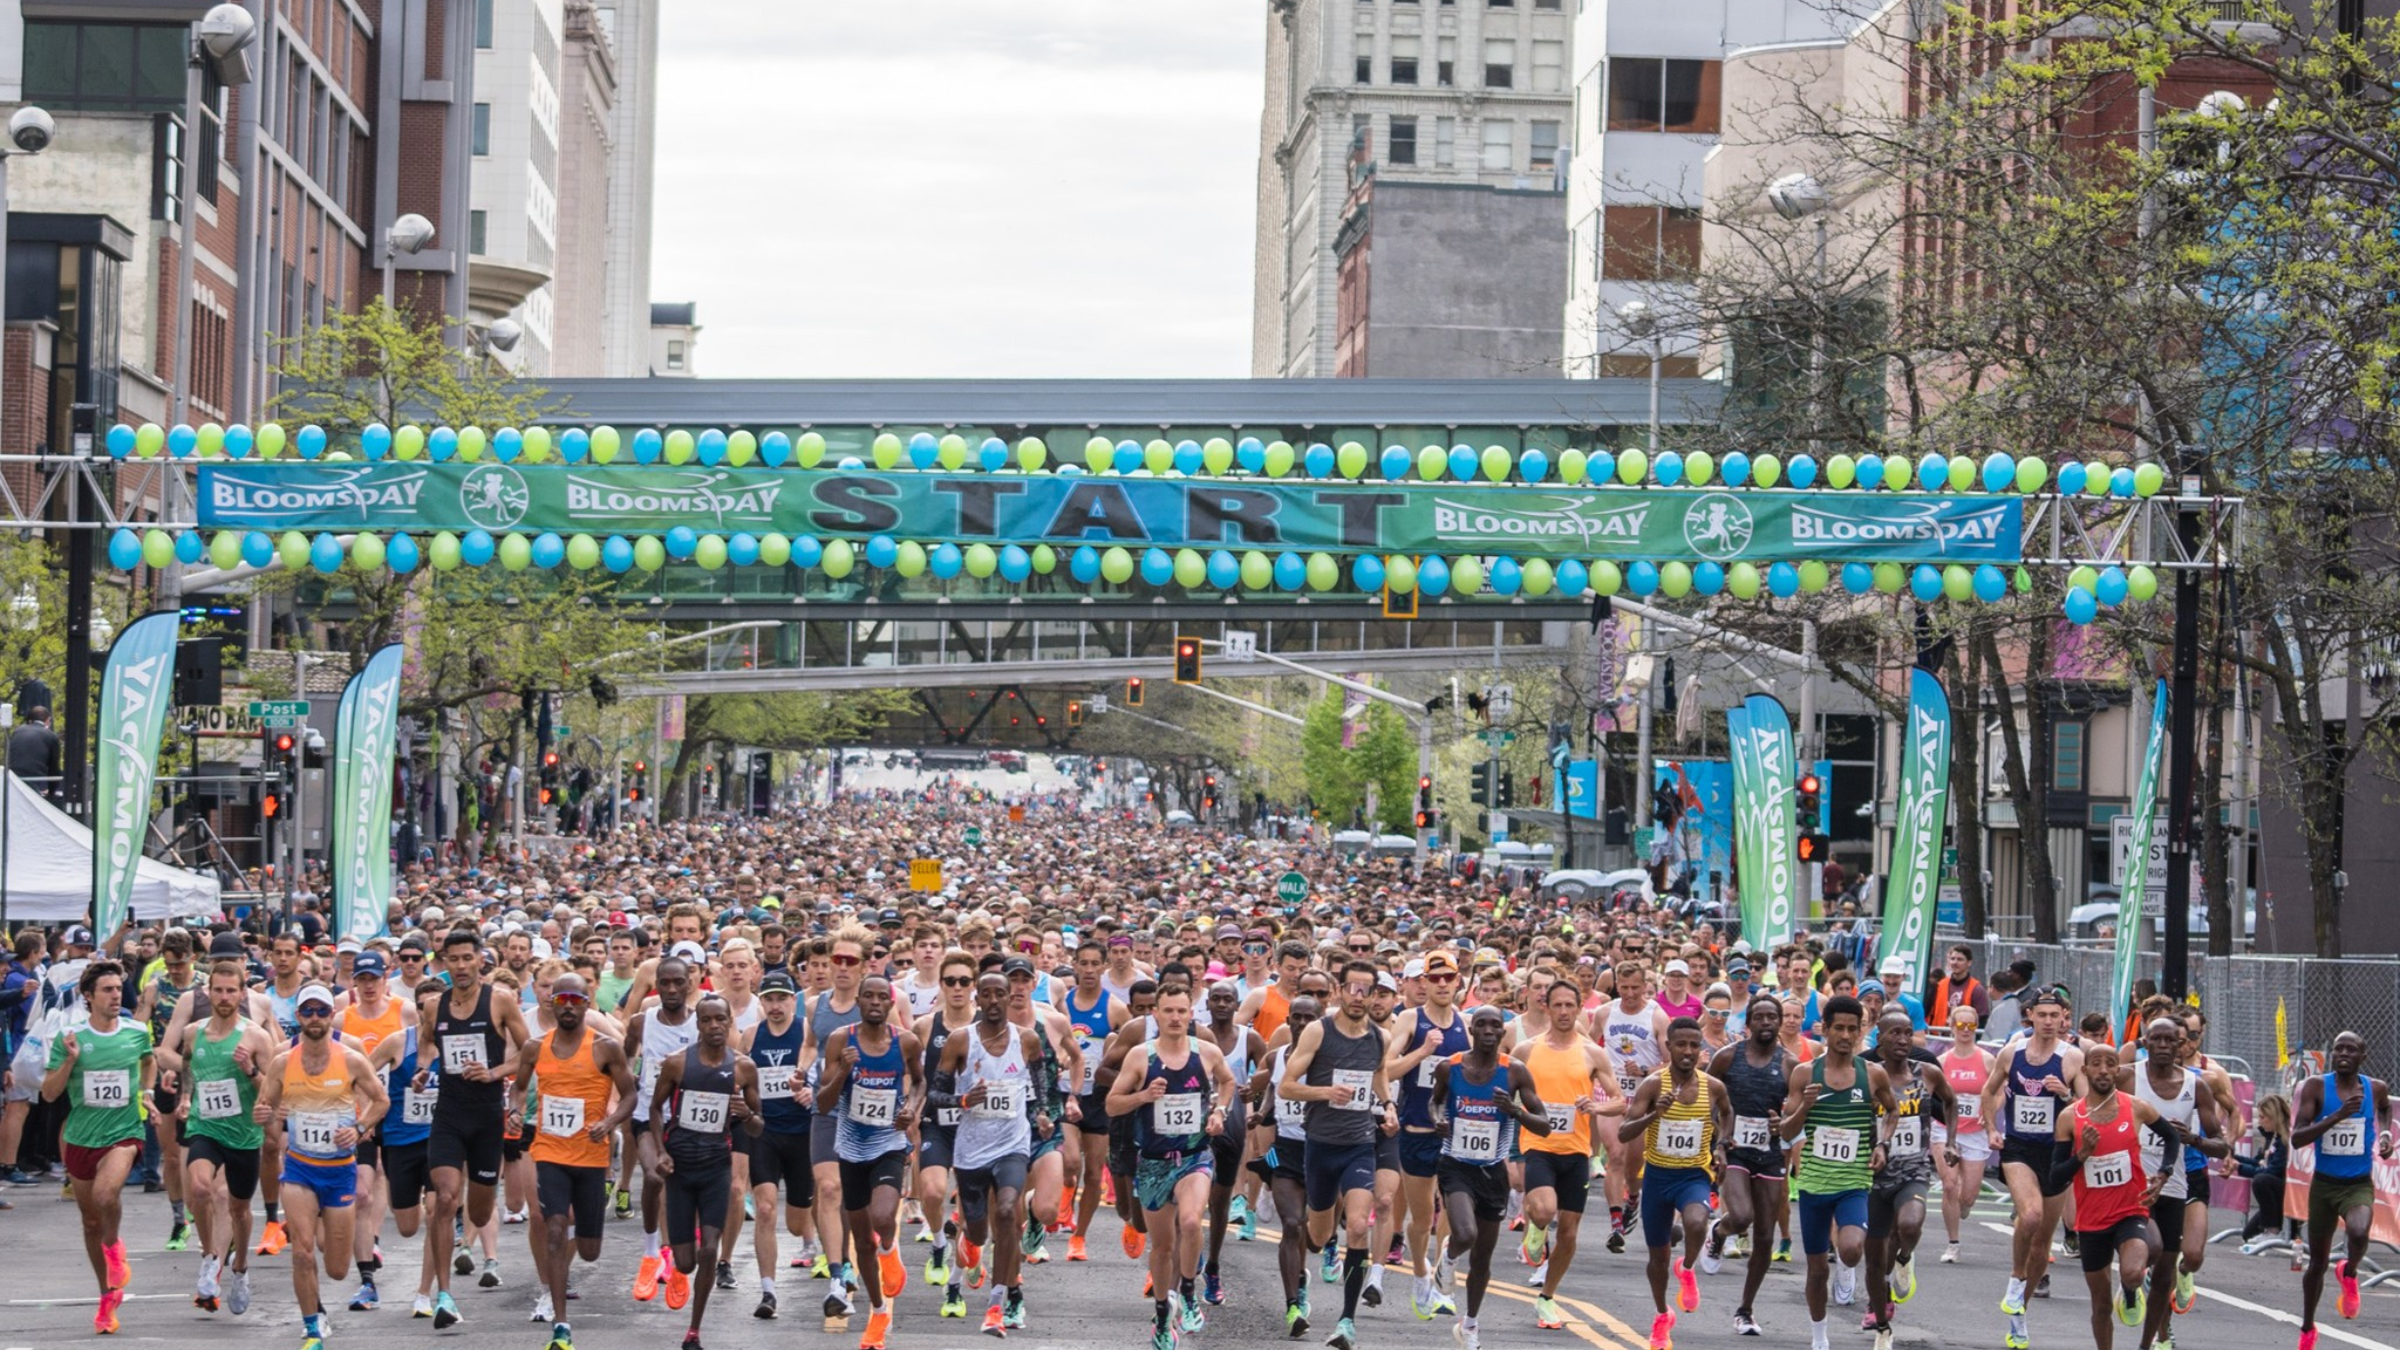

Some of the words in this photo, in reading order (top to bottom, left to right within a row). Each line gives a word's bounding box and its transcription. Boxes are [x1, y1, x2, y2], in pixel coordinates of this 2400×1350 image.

[213, 479, 425, 511] BLOOMSDAY
[568, 482, 780, 513] BLOOMSDAY
[808, 476, 1409, 549] START
[1435, 506, 1648, 536] BLOOMSDAY
[1793, 506, 2003, 540] BLOOMSDAY
[261, 703, 298, 715] Post
[912, 862, 941, 874] YELLOW
[1280, 881, 1307, 894] WALK
[452, 1049, 477, 1065] 151
[862, 1077, 896, 1086] DEPOT
[94, 1085, 121, 1099] 120
[205, 1094, 232, 1110] 115
[858, 1102, 887, 1118] 124
[983, 1096, 1010, 1110] 105
[1465, 1105, 1498, 1114] DEPOT
[549, 1112, 575, 1128] 117
[691, 1107, 719, 1123] 130
[1164, 1110, 1193, 1125] 132
[2021, 1110, 2047, 1125] 322
[303, 1128, 331, 1144] 114
[1462, 1135, 1490, 1151] 106
[1667, 1135, 1694, 1150] 104
[1743, 1131, 1767, 1144] 126
[2331, 1133, 2358, 1147] 107
[1822, 1142, 1850, 1159] 110
[2094, 1168, 2123, 1185] 101
